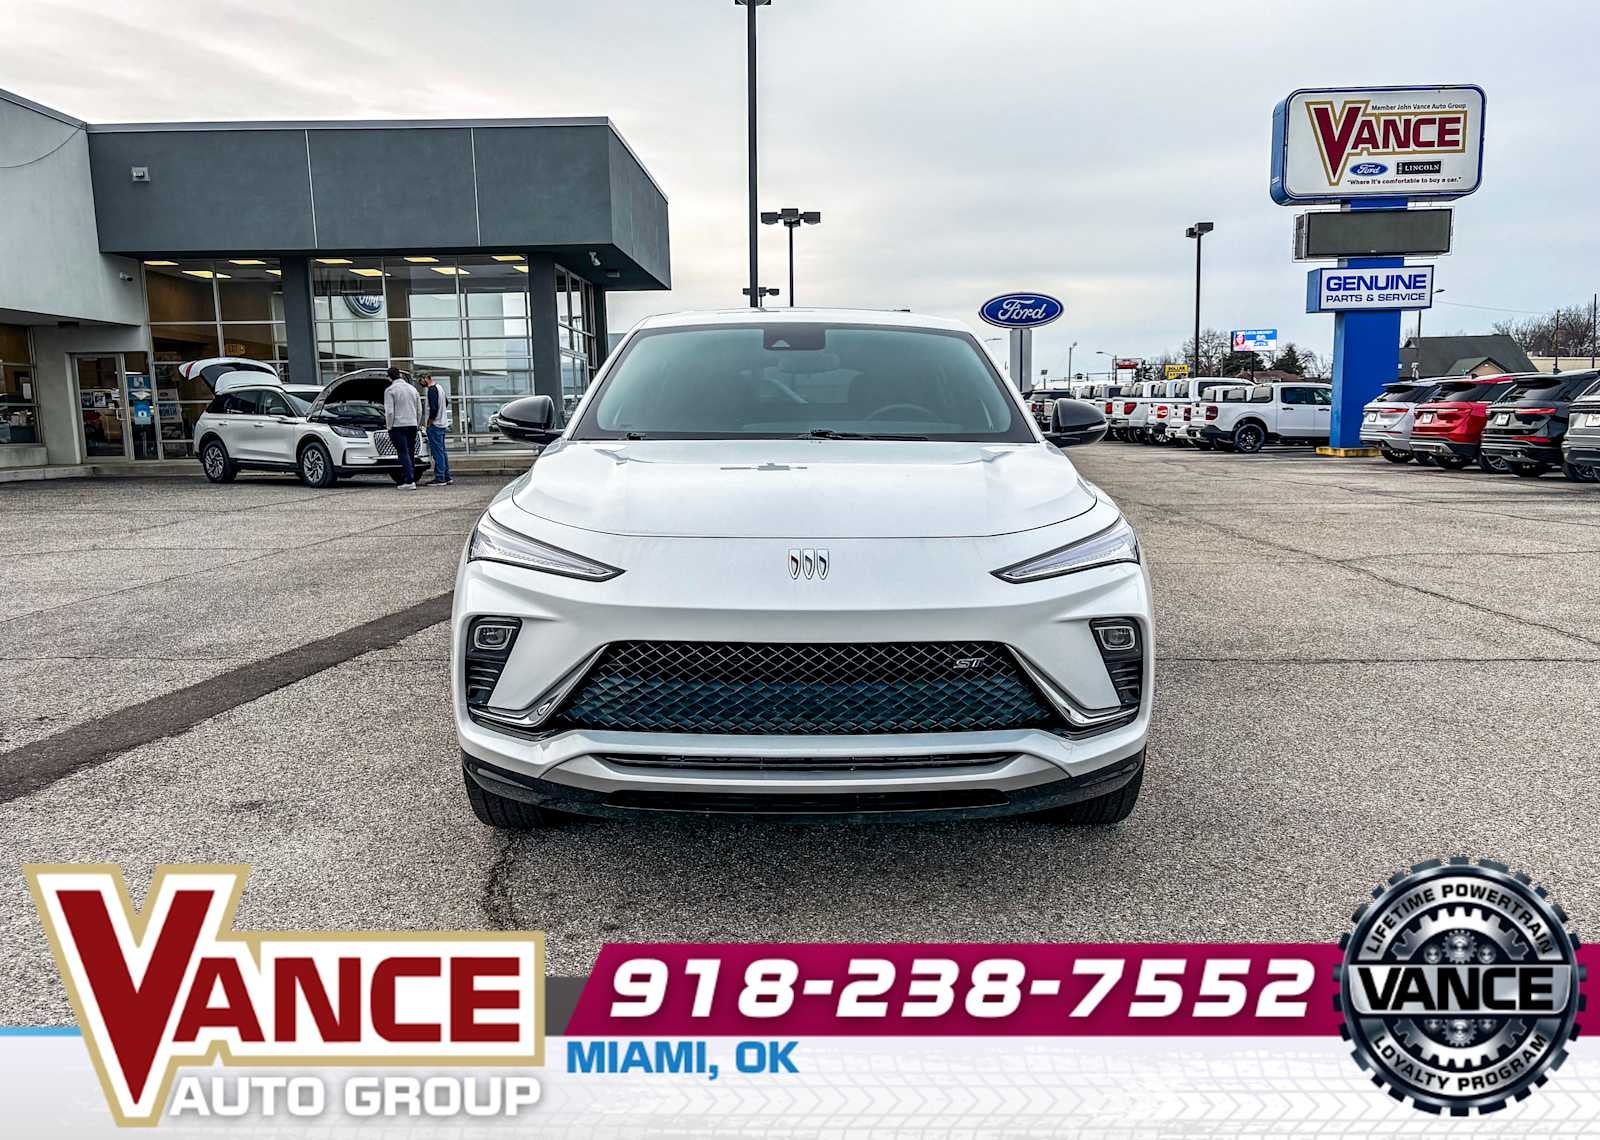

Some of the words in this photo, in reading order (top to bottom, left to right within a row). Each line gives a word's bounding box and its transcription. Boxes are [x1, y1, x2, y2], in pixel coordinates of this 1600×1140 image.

[1397, 103, 1412, 111] John
[1447, 102, 1467, 110] Group
[1313, 106, 1462, 180] VANCE
[1356, 163, 1381, 174] Ford
[1404, 163, 1440, 172] LINCOLN
[1382, 177, 1420, 185] comfortable
[1326, 274, 1427, 292] GENUINE
[1326, 294, 1363, 303] PARTS
[1366, 294, 1374, 302] &
[1377, 293, 1425, 302] SERVICE
[998, 299, 1047, 320] Ford
[953, 657, 986, 669] ST
